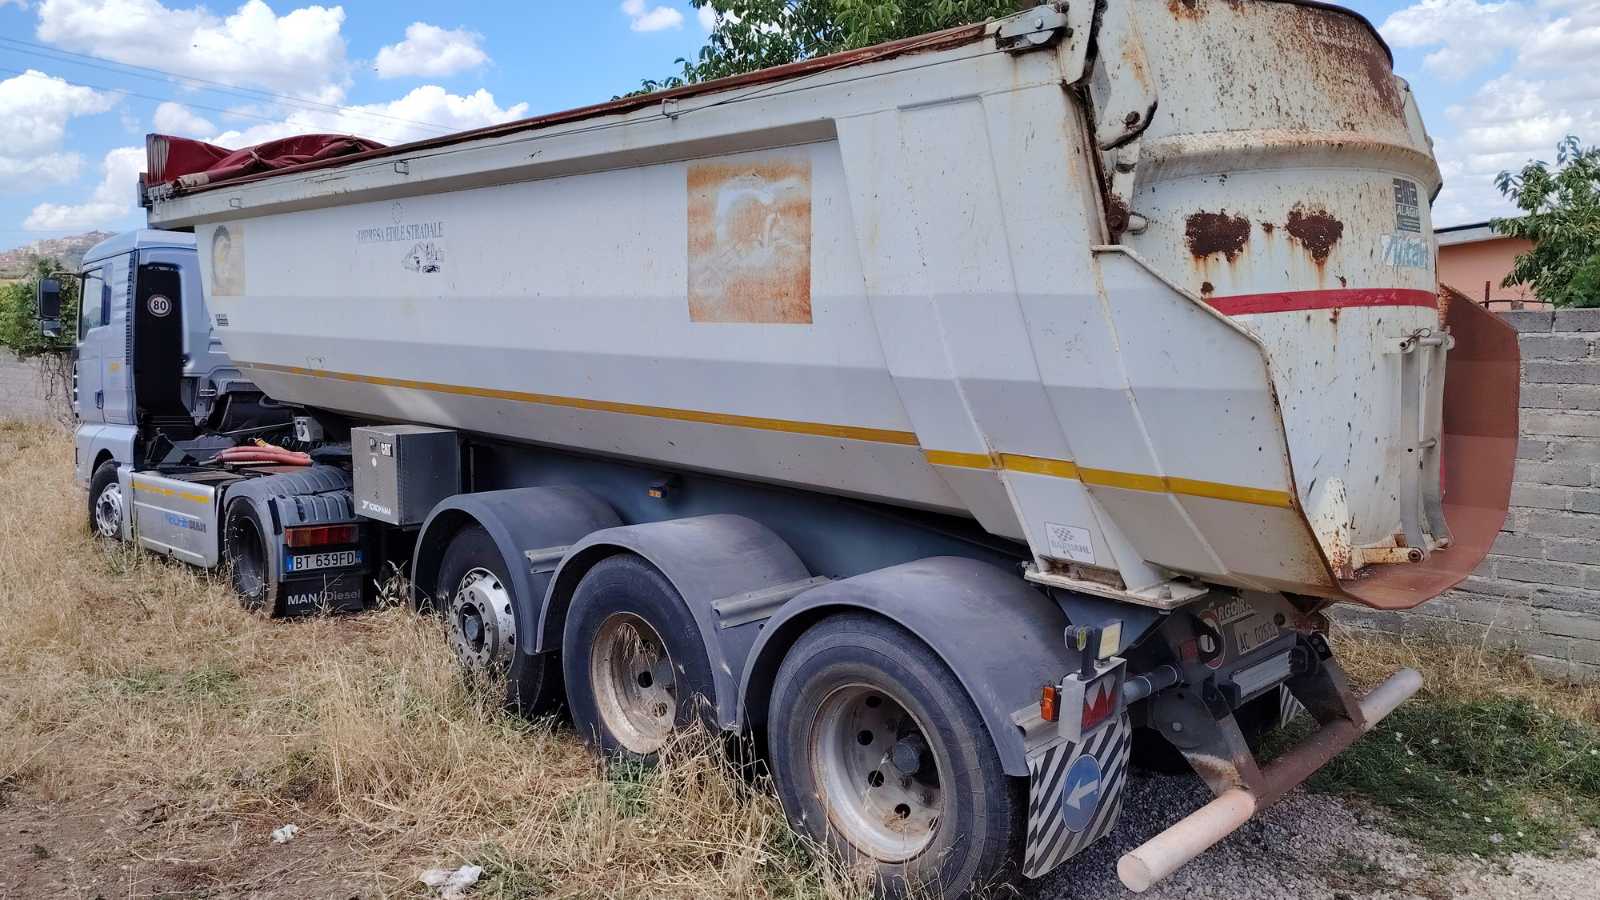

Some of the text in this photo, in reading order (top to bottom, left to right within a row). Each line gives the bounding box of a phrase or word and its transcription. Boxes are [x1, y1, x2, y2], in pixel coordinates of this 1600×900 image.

[407, 221, 444, 240] STRADALE
[153, 300, 166, 311] 80
[381, 442, 392, 456] CAT
[295, 551, 354, 569] BT 639FD
[287, 588, 360, 605] MAN Diesel
